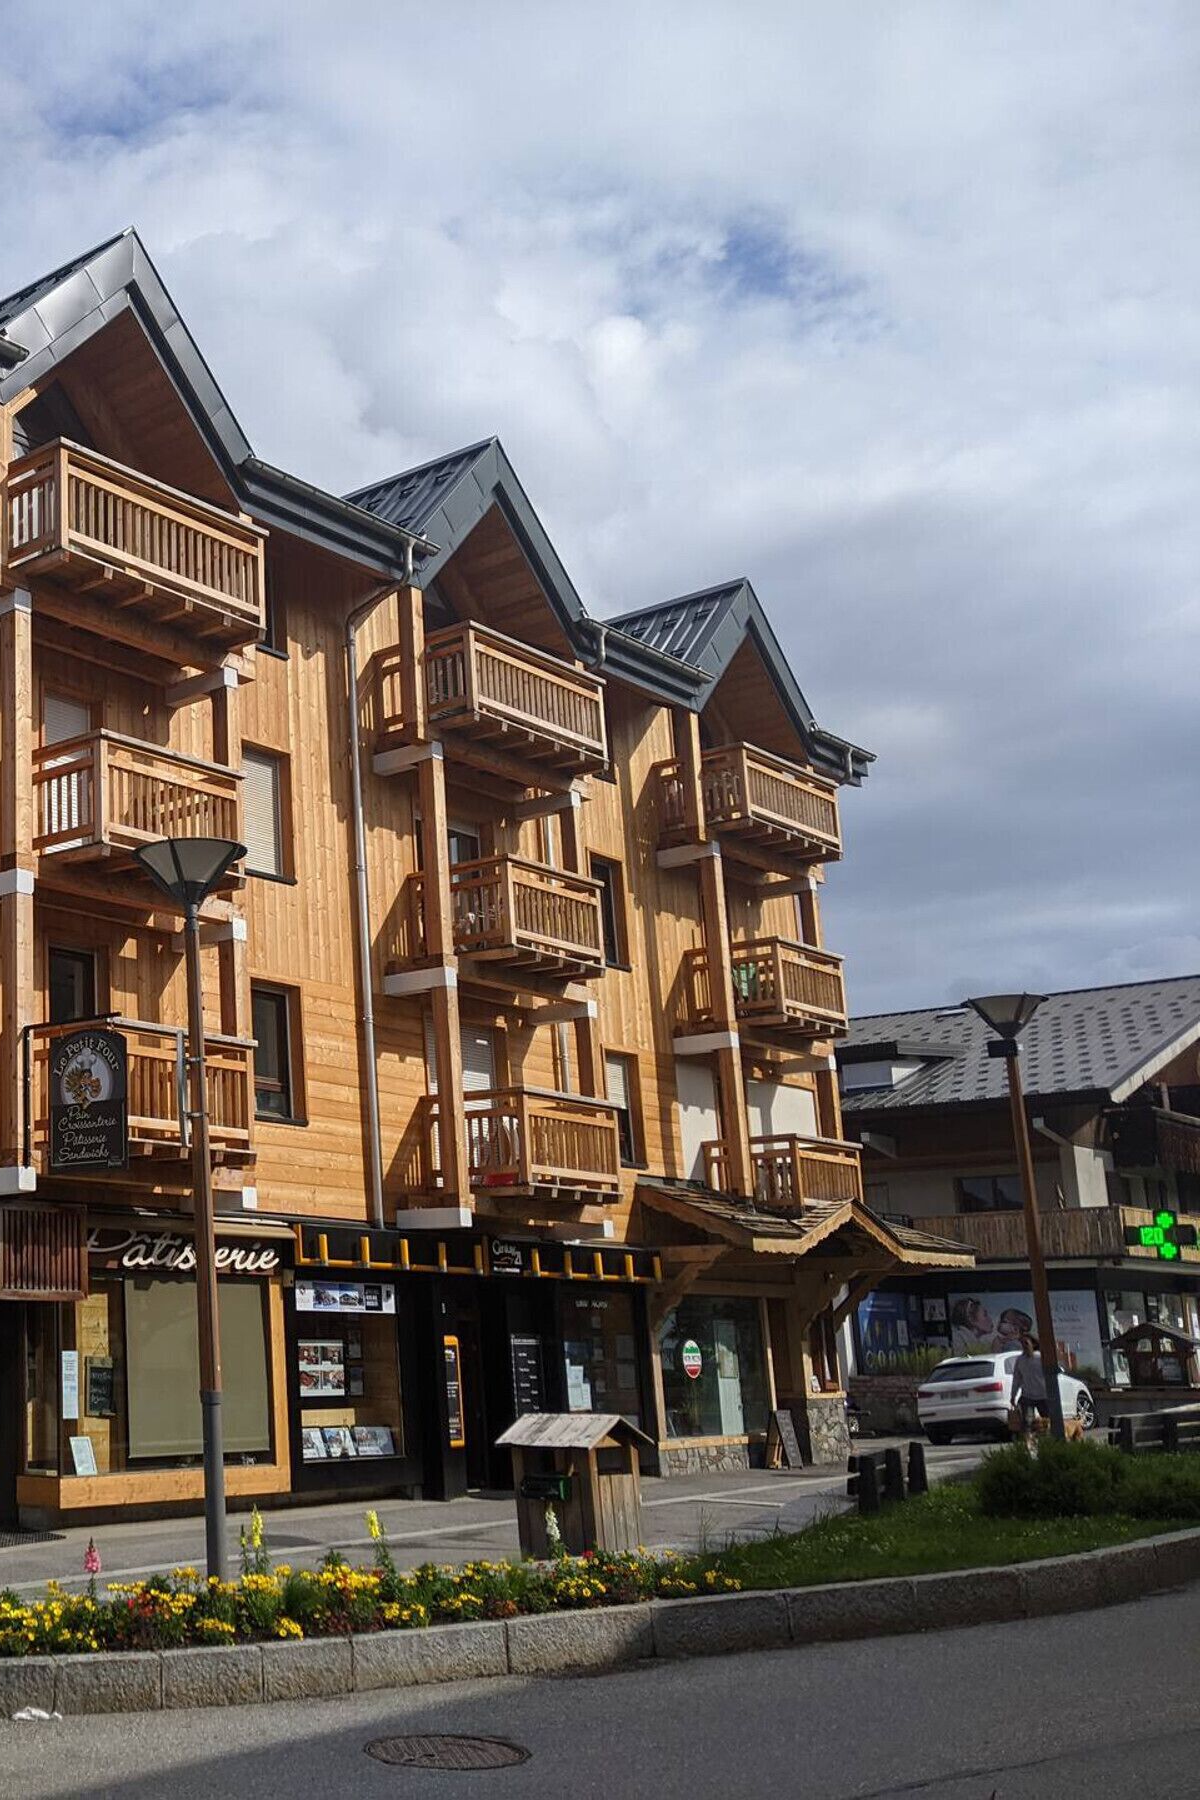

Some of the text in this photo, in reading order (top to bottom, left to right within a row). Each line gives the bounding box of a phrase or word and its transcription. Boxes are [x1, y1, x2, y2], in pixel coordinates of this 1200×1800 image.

[52, 1037, 119, 1076] Le Petit Four
[67, 1105, 90, 1121] Pain
[87, 1228, 280, 1271] Pâtiserie
